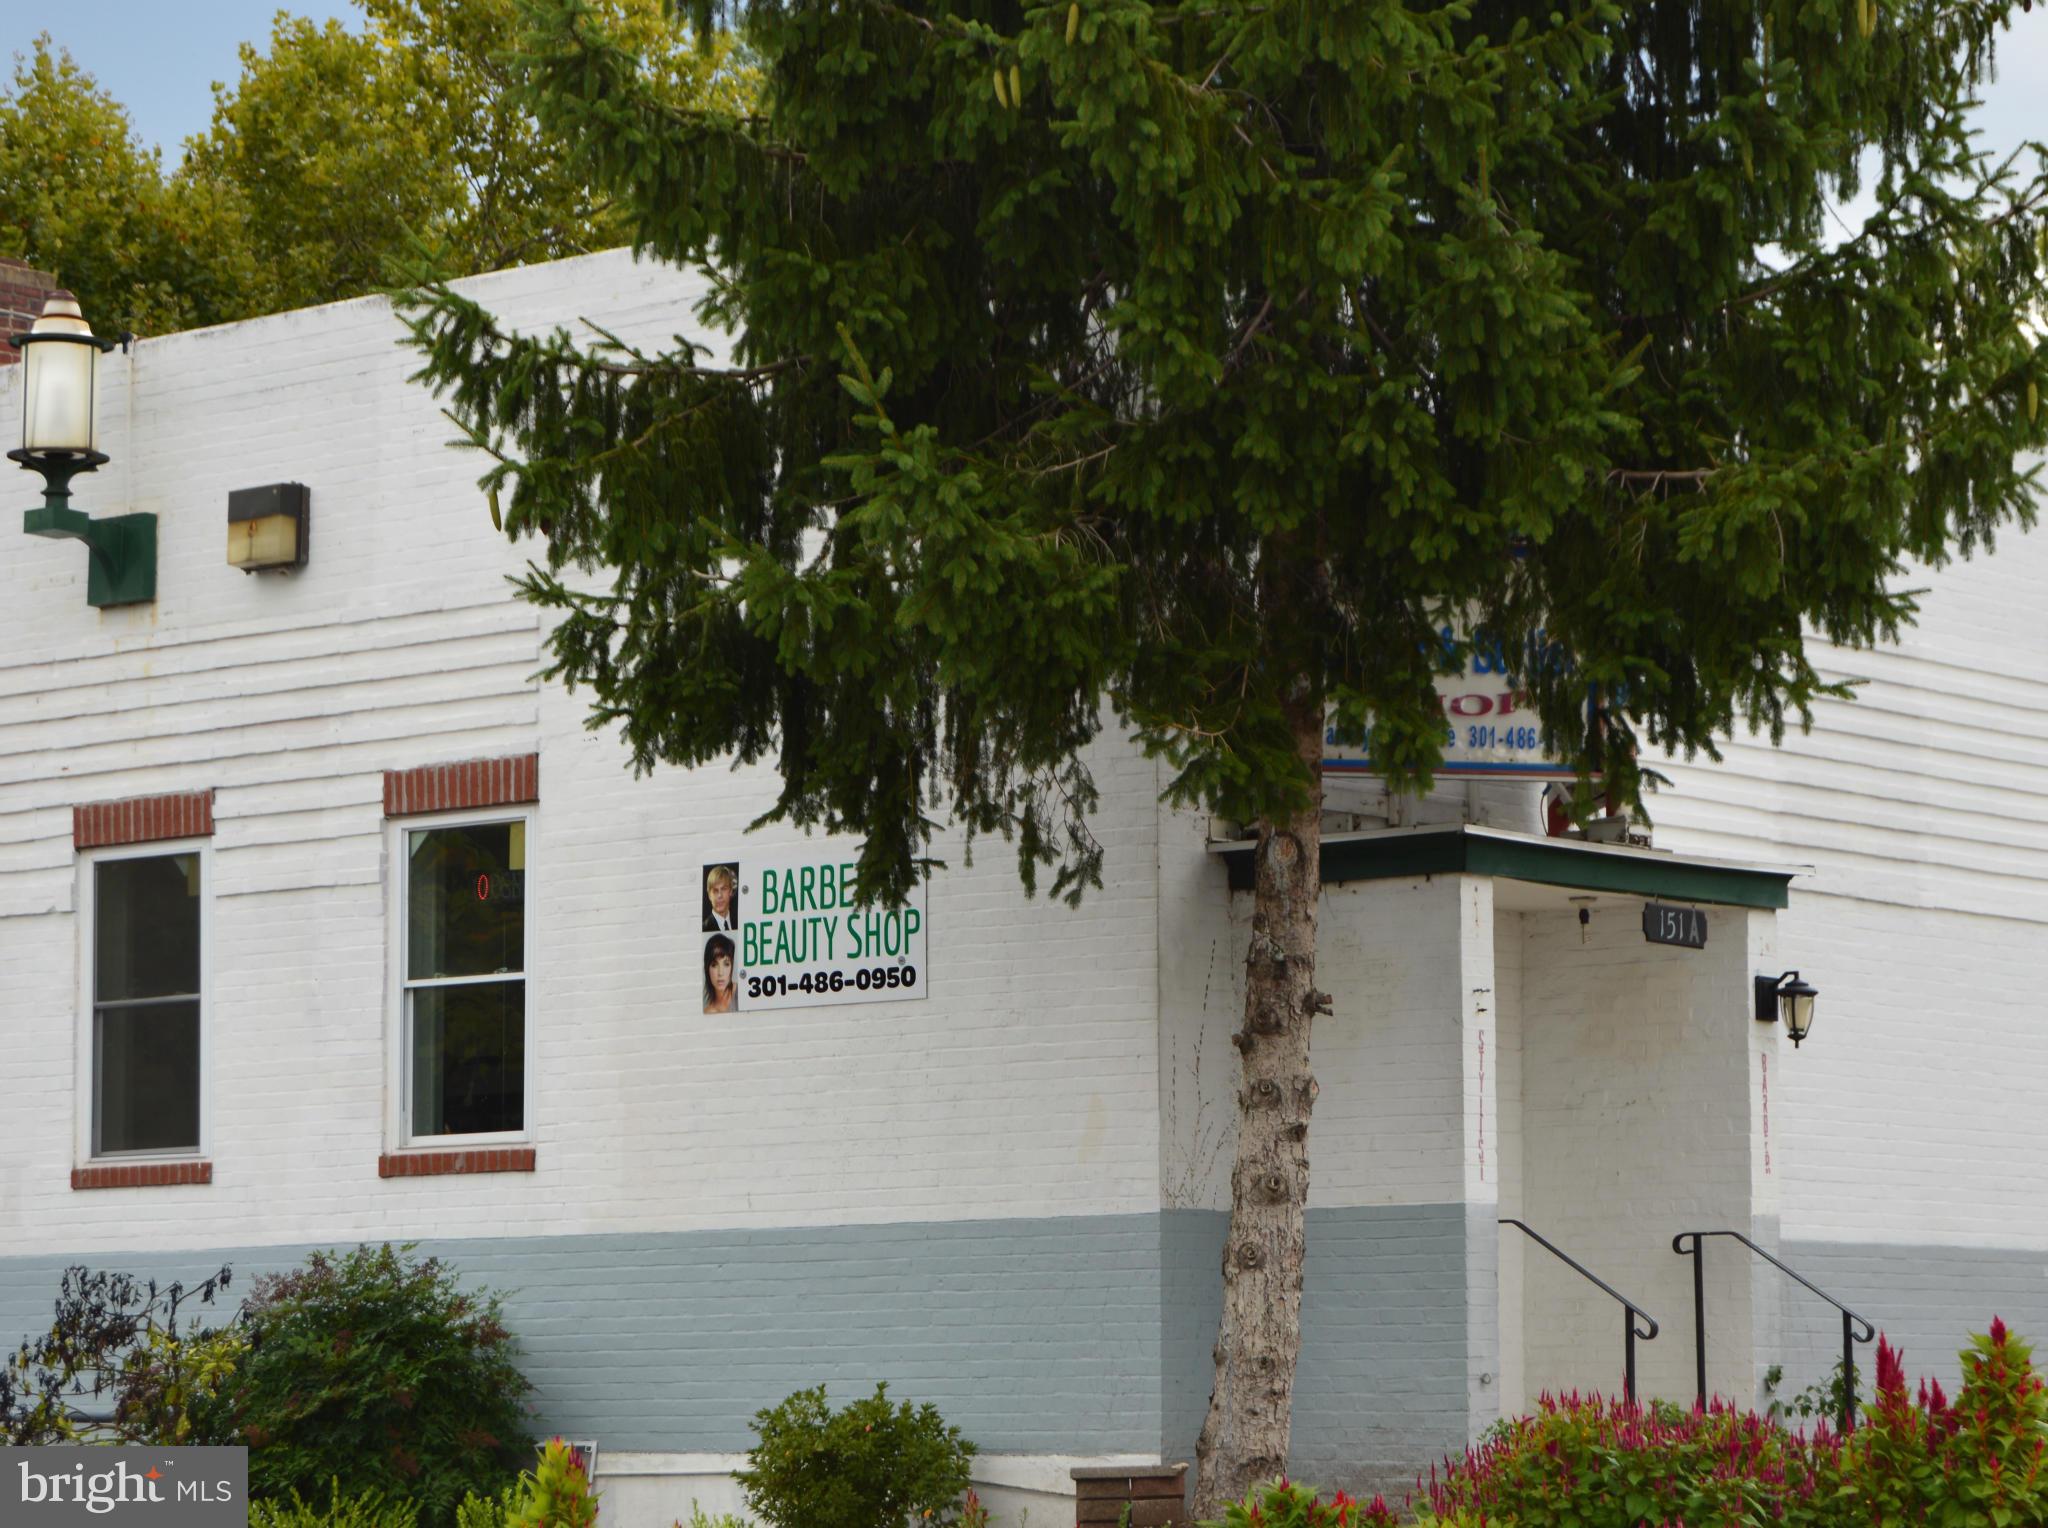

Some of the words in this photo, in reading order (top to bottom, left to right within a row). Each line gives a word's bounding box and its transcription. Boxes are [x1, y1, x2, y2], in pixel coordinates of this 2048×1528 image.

[761, 862, 856, 915] BARBE
[743, 915, 838, 967] BEAUTY
[846, 908, 921, 960] SHOP
[747, 965, 917, 998] 301-486-0950
